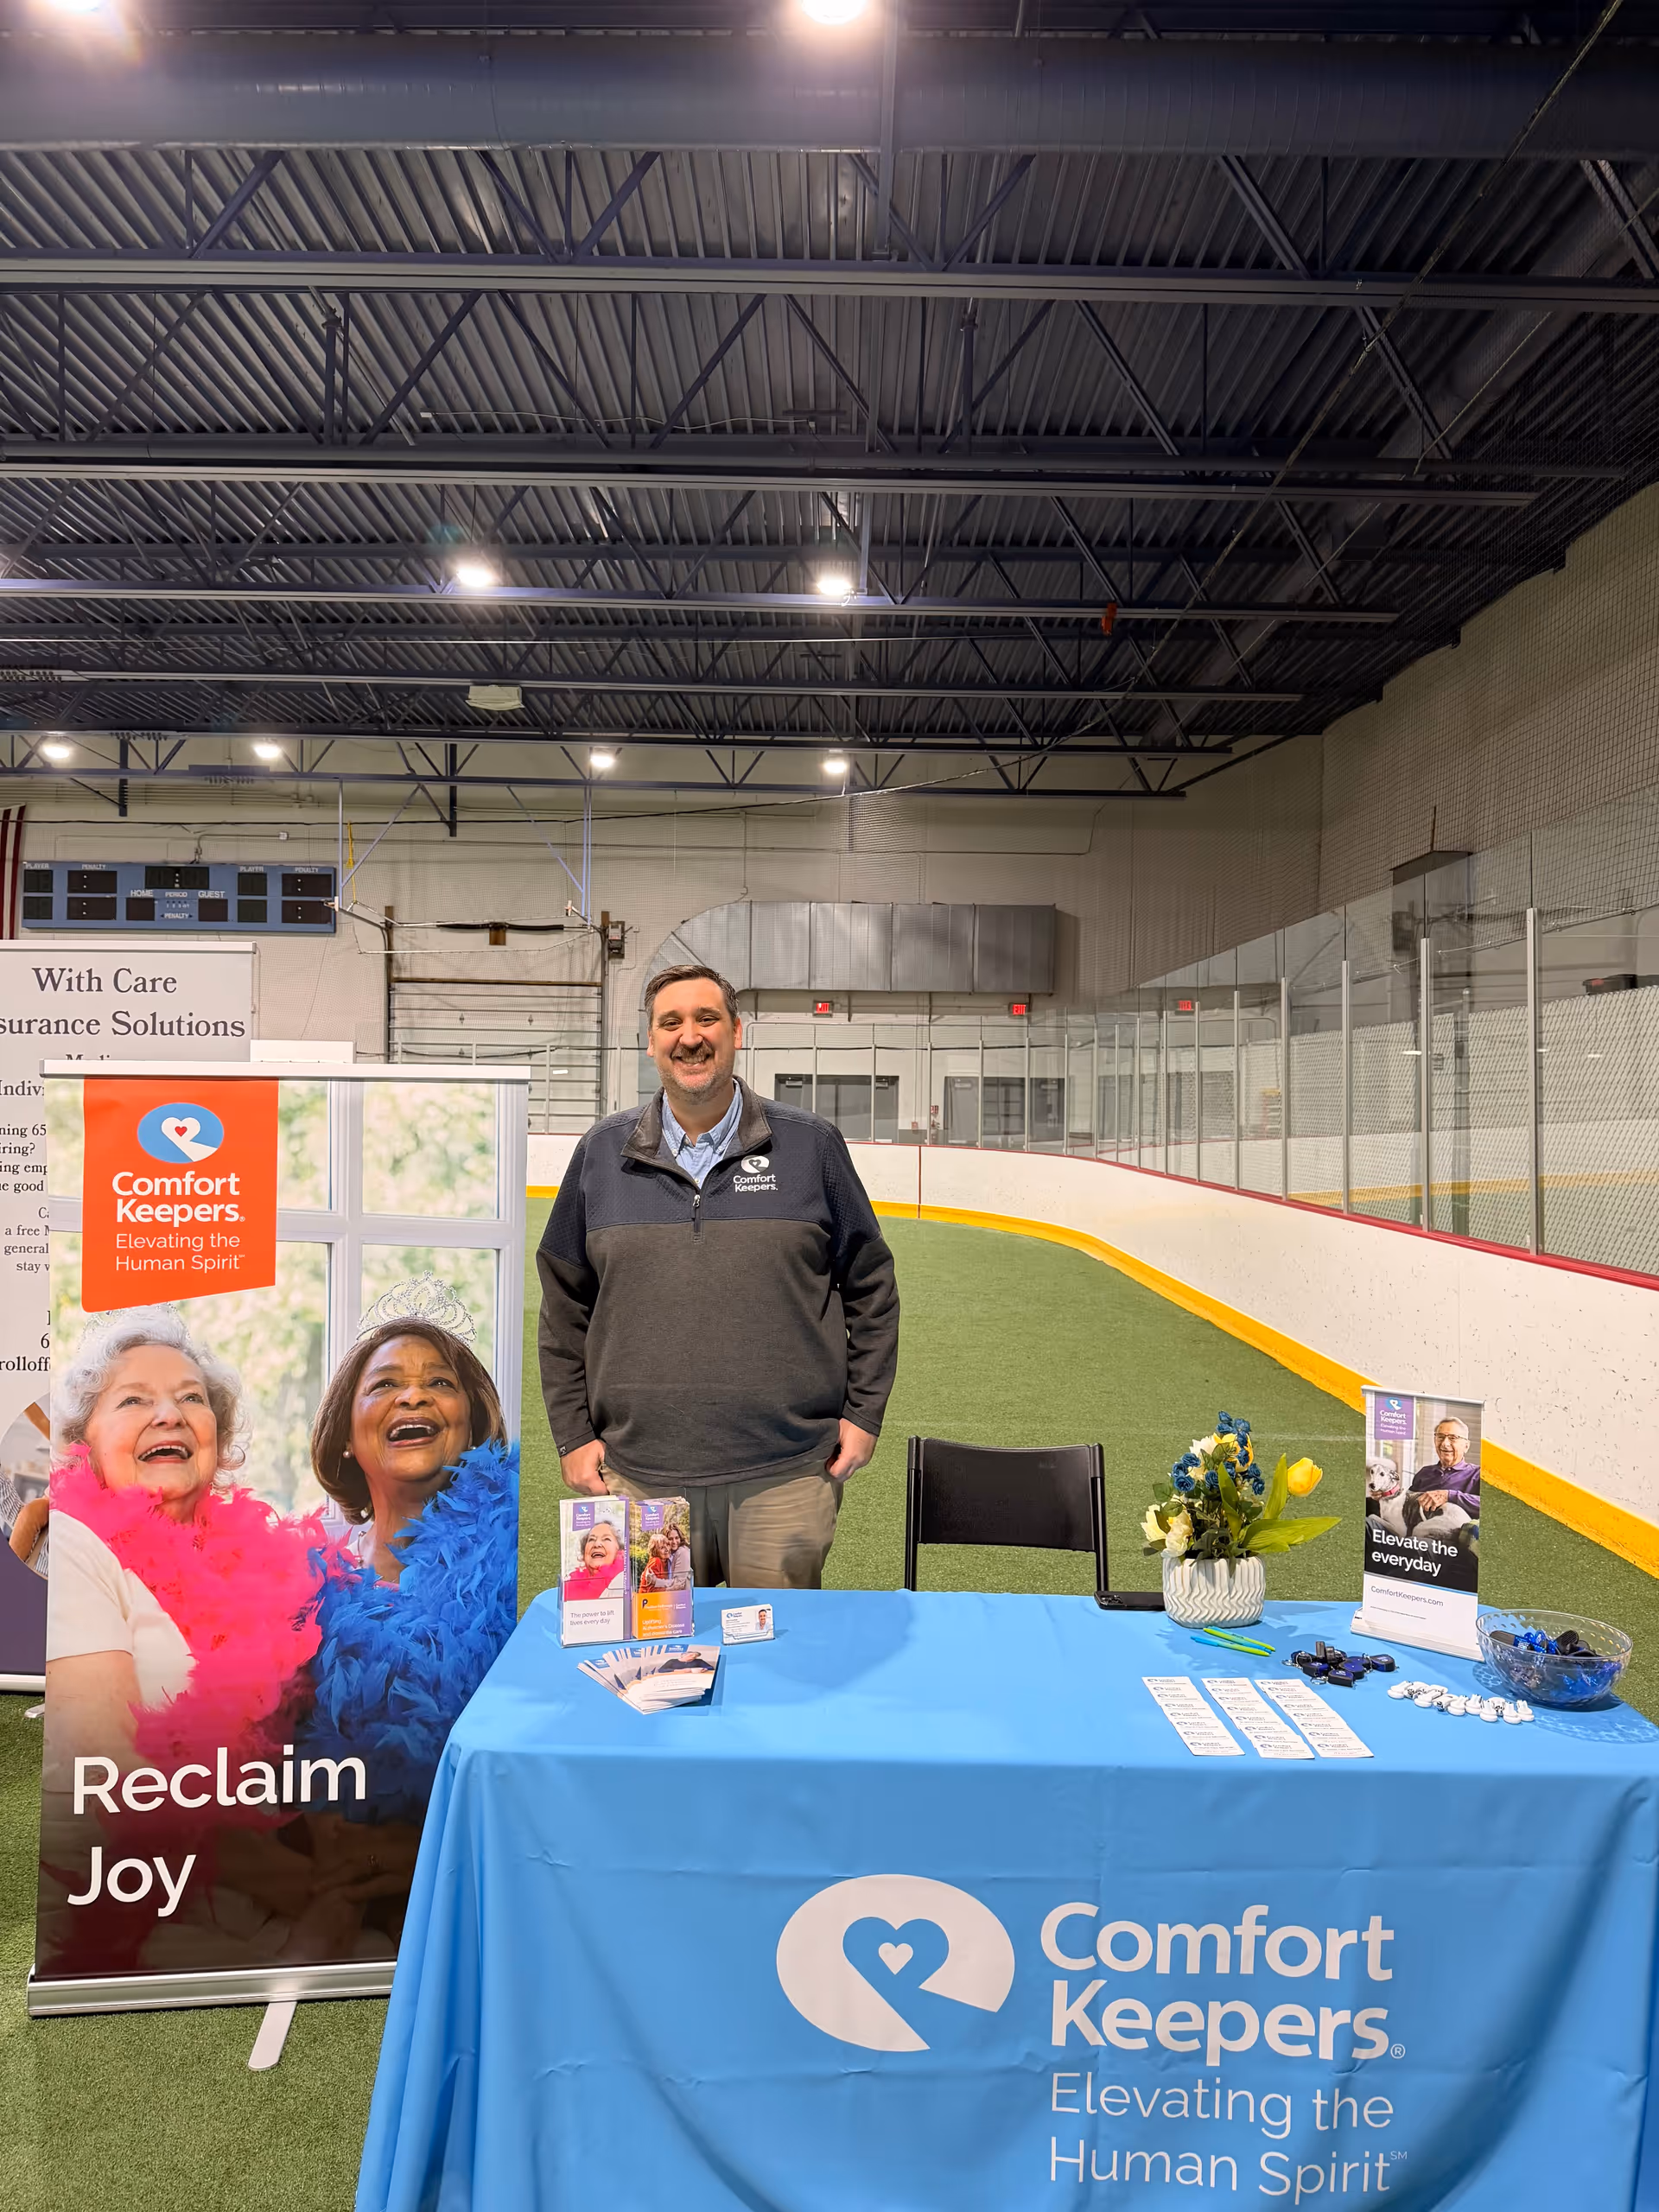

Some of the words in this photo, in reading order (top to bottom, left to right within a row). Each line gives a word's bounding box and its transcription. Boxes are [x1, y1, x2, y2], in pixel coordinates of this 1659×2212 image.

[32, 967, 103, 992] With
[113, 968, 177, 993] Care
[111, 1011, 245, 1037] Solutions
[32, 1124, 46, 1135] 65
[14, 1179, 44, 1193] good
[111, 1171, 240, 1196] Comfort
[733, 1174, 776, 1184] Comfort
[17, 1224, 40, 1236] free
[3, 1243, 49, 1255] general
[116, 1233, 204, 1251] Elevating
[209, 1233, 240, 1248] the
[16, 1262, 41, 1274] stay
[116, 1255, 185, 1270] Human
[1379, 1410, 1406, 1419] Comfort
[1372, 1529, 1429, 1552] Elevate
[1432, 1539, 1458, 1557] the
[1371, 1550, 1441, 1577] everyday
[1370, 1586, 1444, 1606] ComfortKeepers.com
[73, 1744, 366, 1815] Reclaim
[67, 1846, 197, 1917] Joy
[1040, 1902, 1395, 1981] Comfort
[1051, 2071, 1292, 2139] Elevating
[1312, 2088, 1394, 2131] the
[1051, 2136, 1237, 2191] Human
